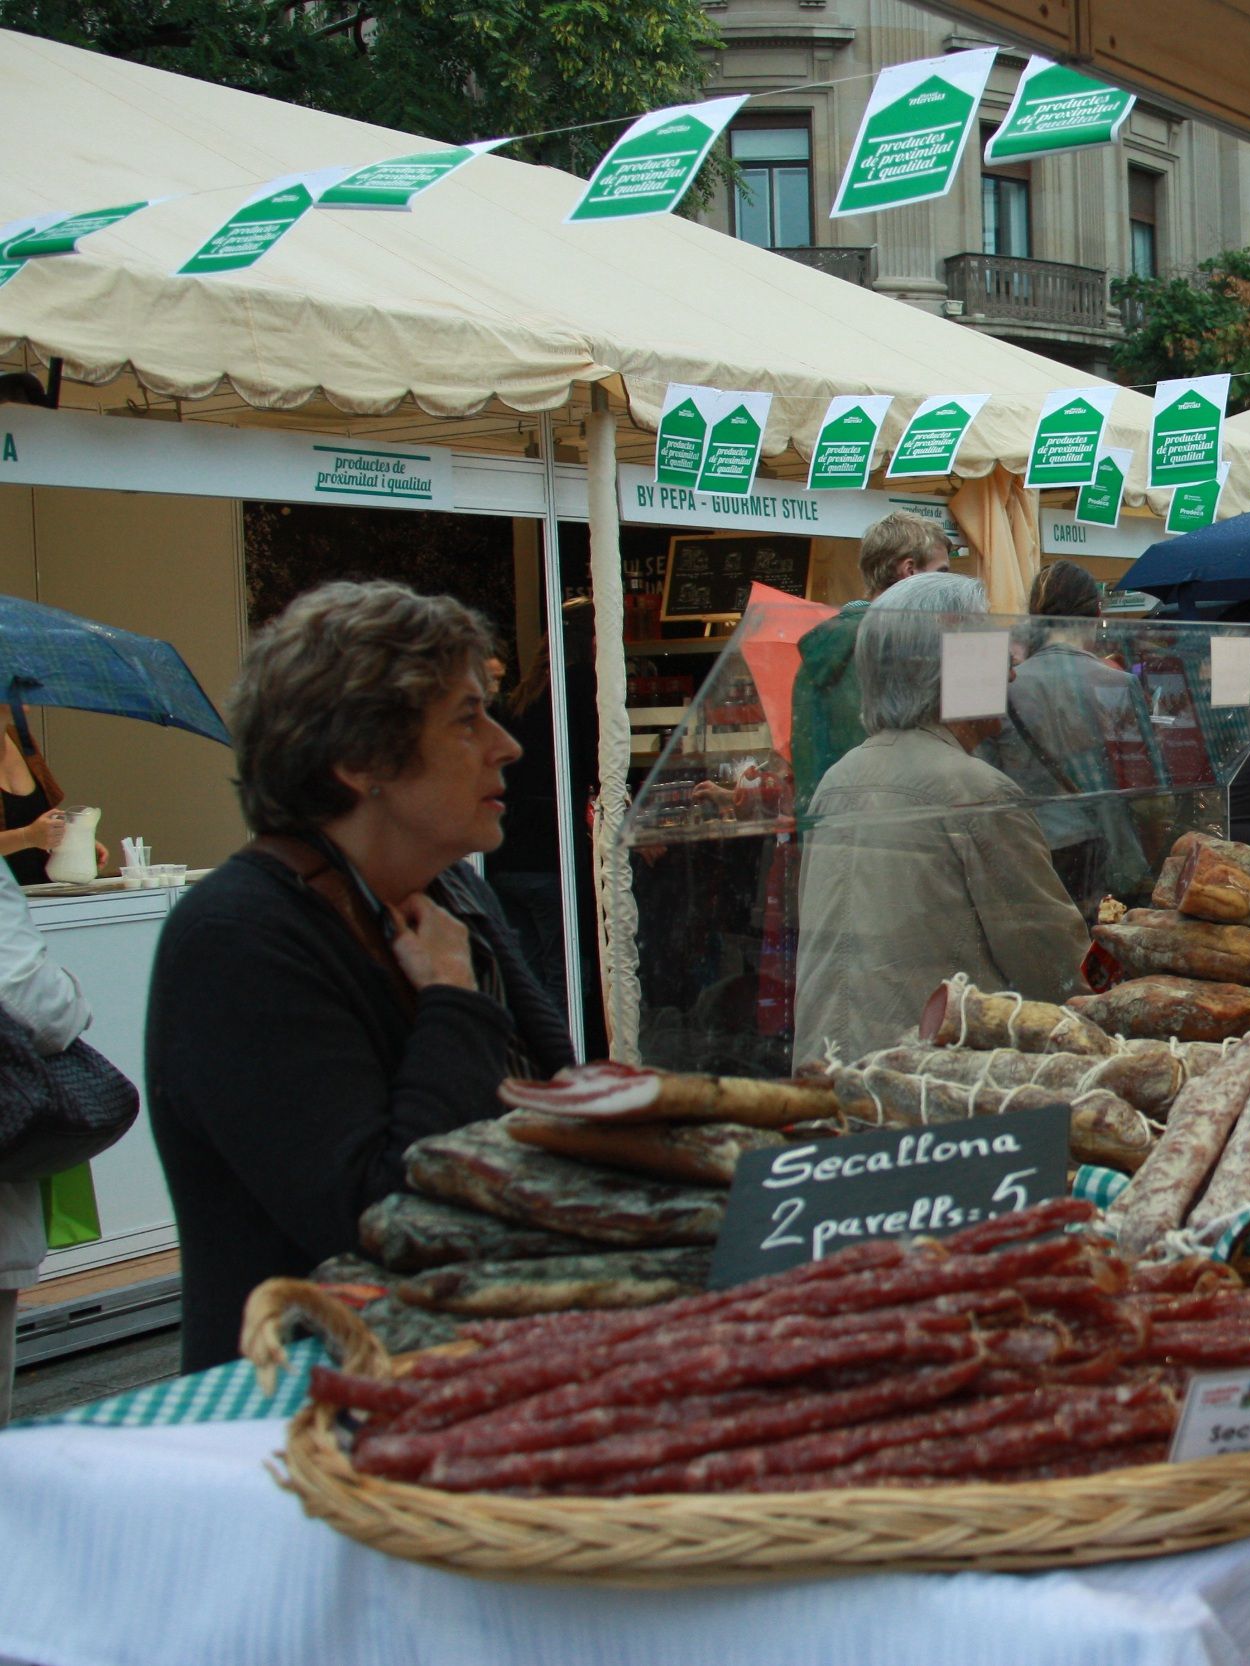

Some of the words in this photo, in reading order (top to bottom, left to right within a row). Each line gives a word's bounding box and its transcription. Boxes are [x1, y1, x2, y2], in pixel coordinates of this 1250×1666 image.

[1017, 114, 1036, 125] de
[1037, 101, 1121, 122] proximitat
[1034, 94, 1111, 116] productes
[1024, 124, 1029, 132] i
[1036, 114, 1100, 131] qualitat
[861, 157, 879, 168] de
[878, 140, 954, 169] proximitat
[876, 132, 946, 158] productes
[600, 174, 617, 186] de
[616, 166, 687, 186] proximitat
[617, 158, 681, 176] productes
[868, 167, 875, 180] i
[879, 156, 937, 181] qualitat
[604, 185, 612, 196] i
[614, 180, 668, 196] qualitat
[3, 433, 18, 461] A
[1046, 436, 1088, 447] productes
[1157, 445, 1167, 455] de
[1168, 440, 1215, 456] proximitat
[1165, 432, 1207, 446] productes
[1037, 446, 1048, 454] de
[1048, 443, 1093, 456] proximitat
[1042, 455, 1047, 463] i
[1049, 453, 1084, 465] qualitat
[1163, 454, 1167, 464] i
[1170, 451, 1205, 465] qualitat
[335, 456, 390, 473] productes
[393, 461, 406, 474] de
[317, 471, 379, 488] proximitat
[382, 475, 386, 488] i
[388, 477, 432, 492] qualitat
[637, 485, 654, 507] BY
[661, 487, 697, 511] PEPA
[783, 498, 819, 521] STYLE
[1053, 525, 1086, 543] CAROLI
[762, 1132, 1022, 1189] Secallona
[760, 1197, 805, 1250] 2
